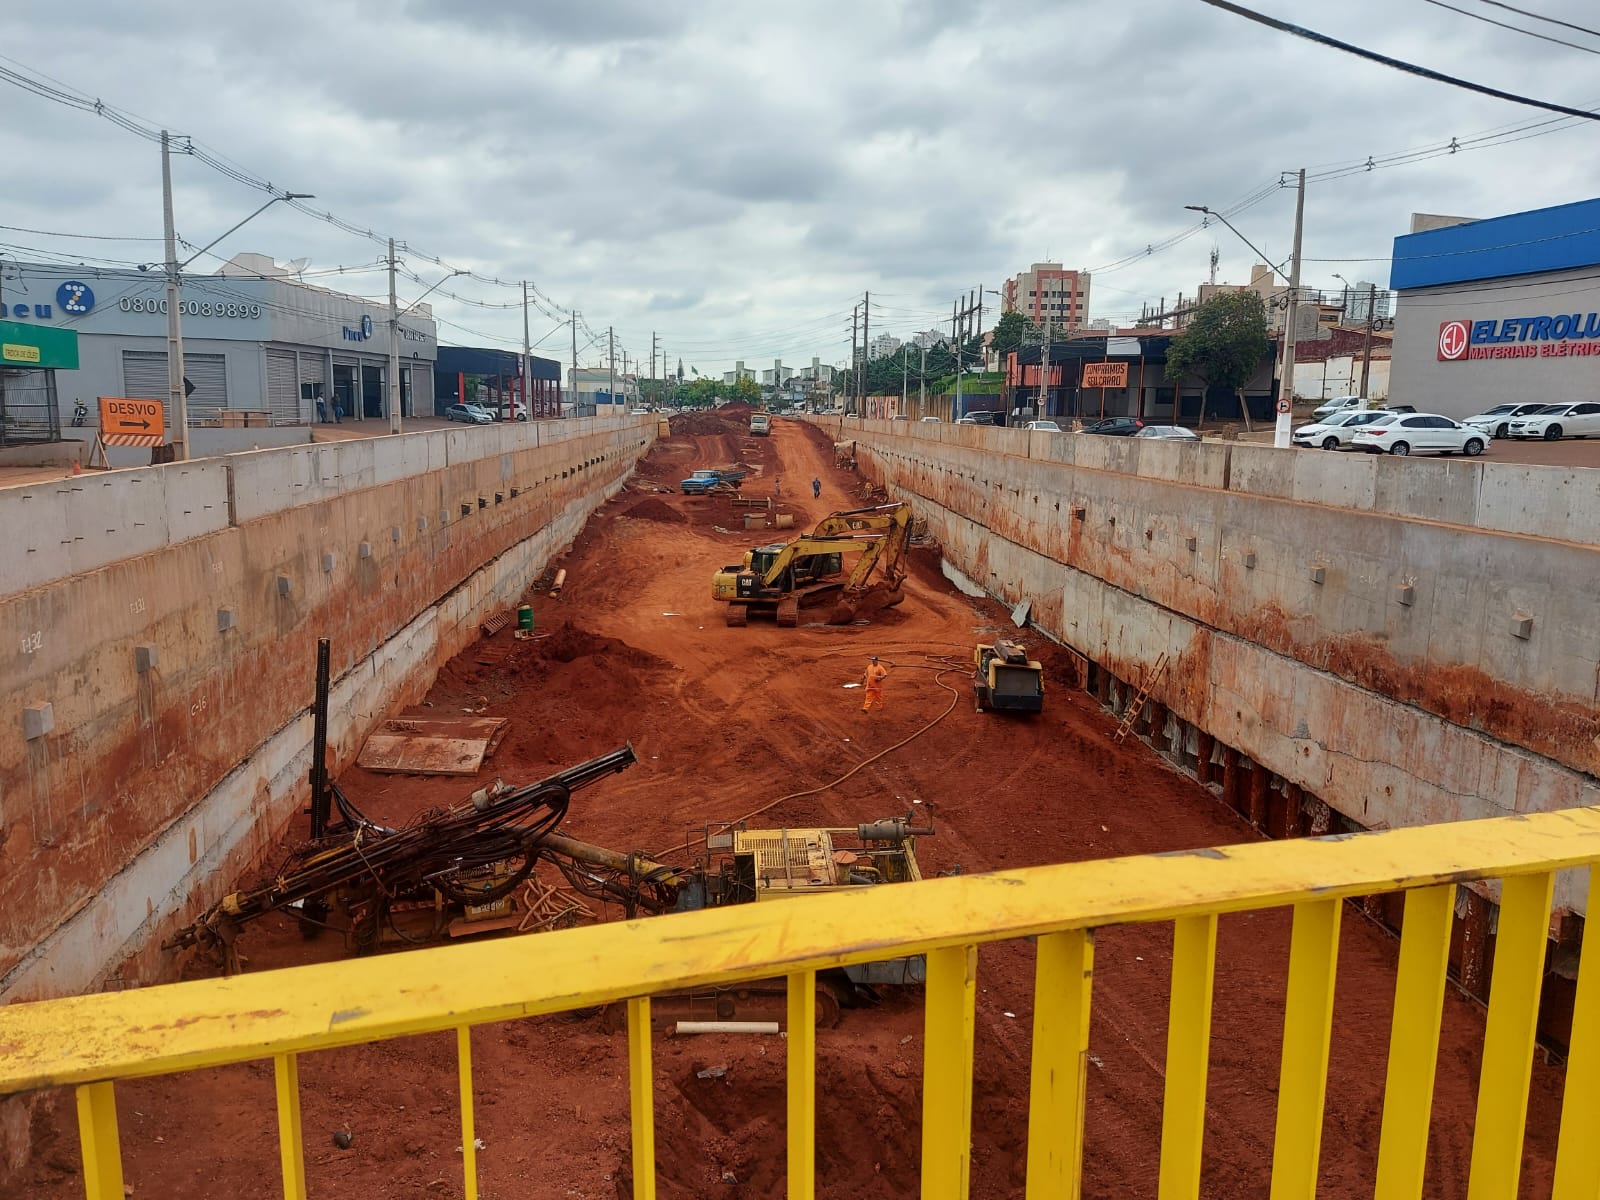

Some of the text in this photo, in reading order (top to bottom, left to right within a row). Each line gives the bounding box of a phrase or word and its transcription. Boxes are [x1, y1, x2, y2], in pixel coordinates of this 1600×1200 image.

[1469, 345, 1537, 360] MATERIAIS
[1086, 363, 1125, 375] COMPRAMOS
[1087, 375, 1121, 387] SEU CARRO
[109, 402, 156, 415] DESVIO
[741, 578, 753, 587] CAT
